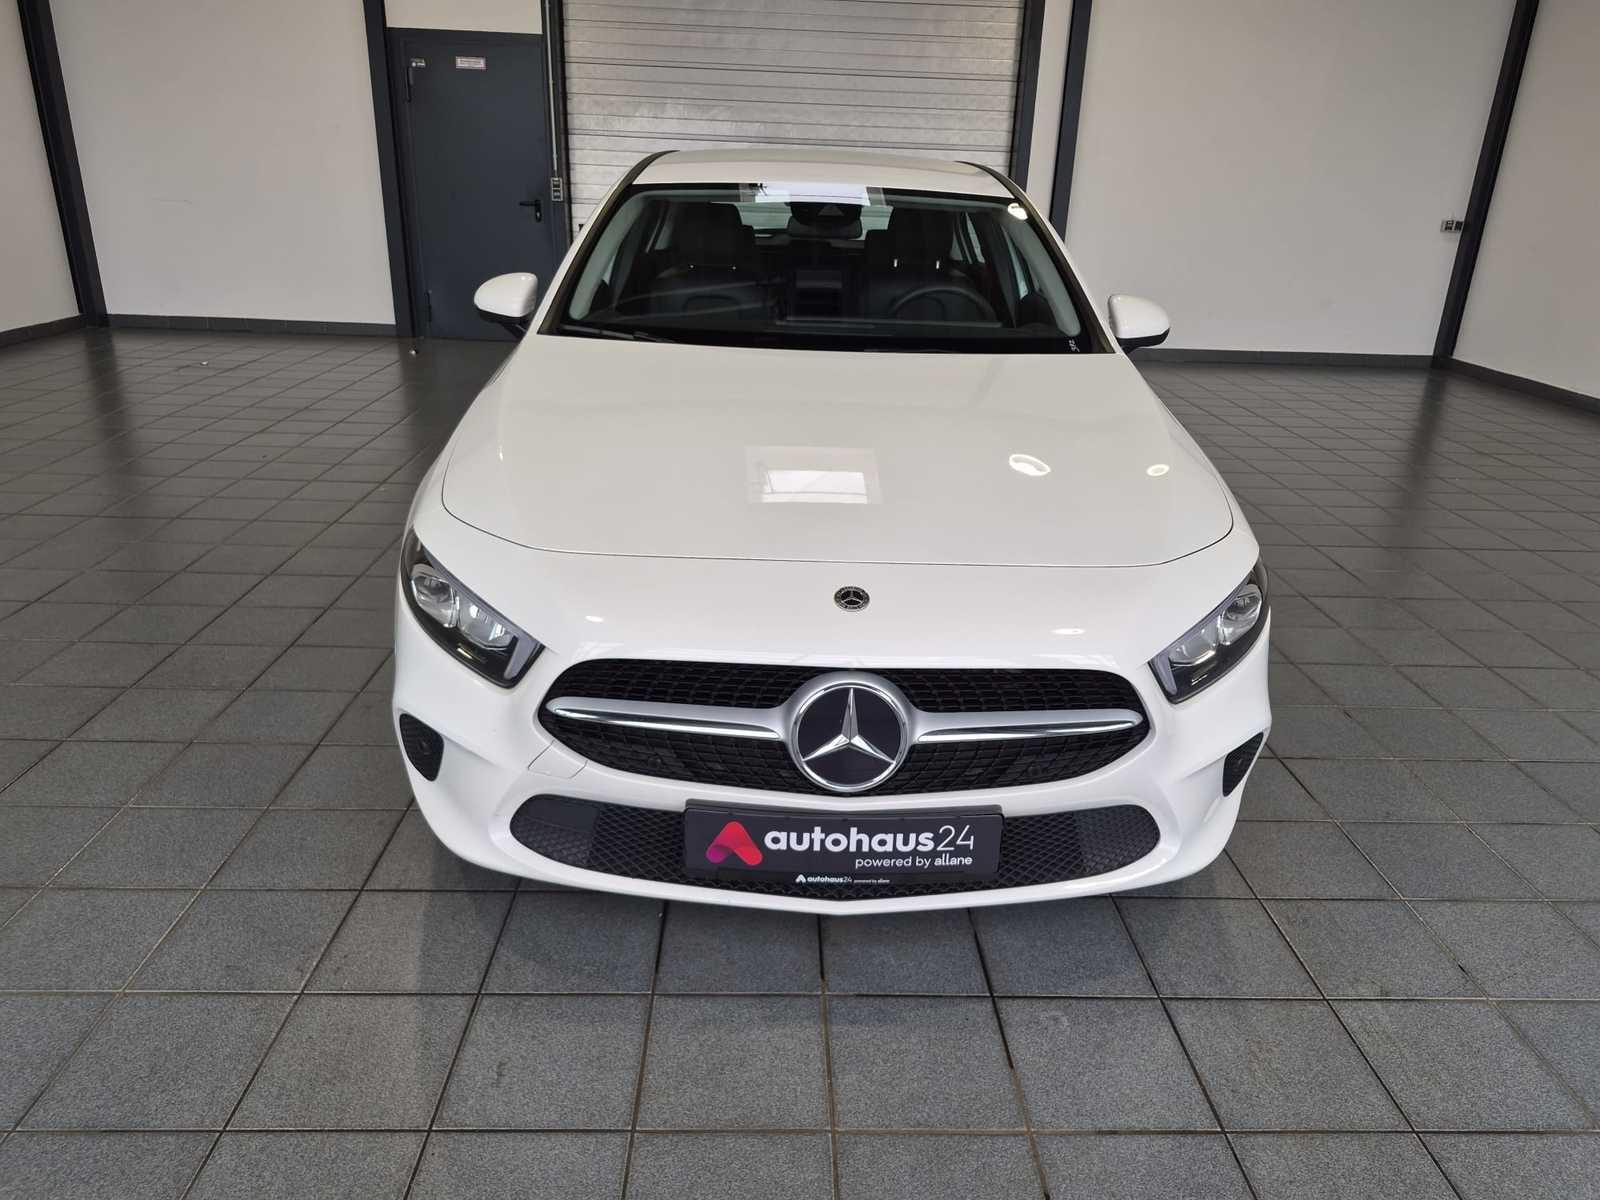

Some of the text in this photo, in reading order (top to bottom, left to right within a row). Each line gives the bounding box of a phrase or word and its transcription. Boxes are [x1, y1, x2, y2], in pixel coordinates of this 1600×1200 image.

[764, 825, 974, 853] autohaus24
[855, 854, 973, 868] powered by allane
[807, 875, 853, 883] autohaus24
